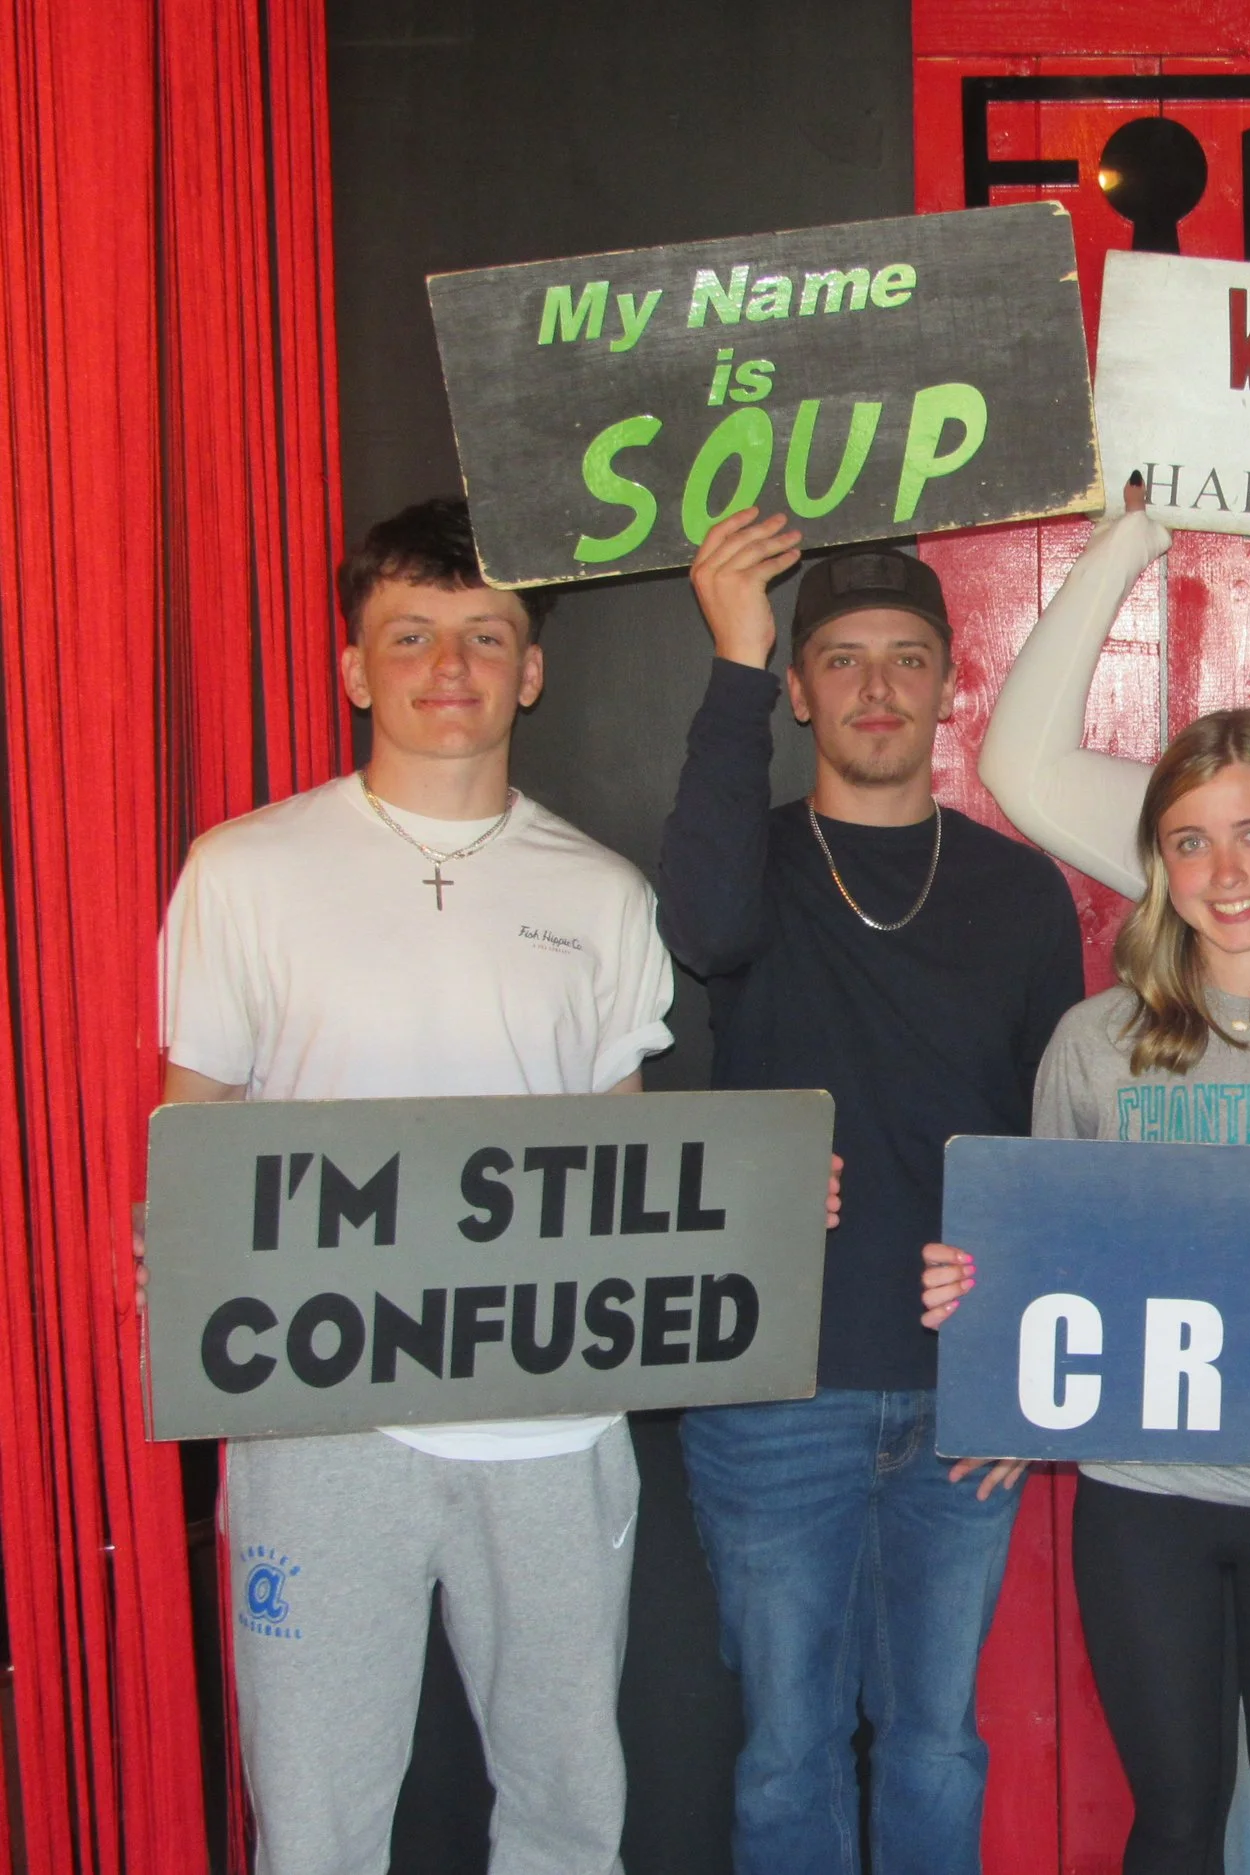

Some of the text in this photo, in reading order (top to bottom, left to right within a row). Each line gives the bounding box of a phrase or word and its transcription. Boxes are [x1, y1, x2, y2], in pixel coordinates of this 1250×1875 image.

[537, 262, 917, 352] My Name
[707, 347, 775, 406] is
[572, 382, 988, 562] SOUP
[252, 1141, 726, 1252] I'M STILL
[200, 1272, 760, 1395] CONFUSED
